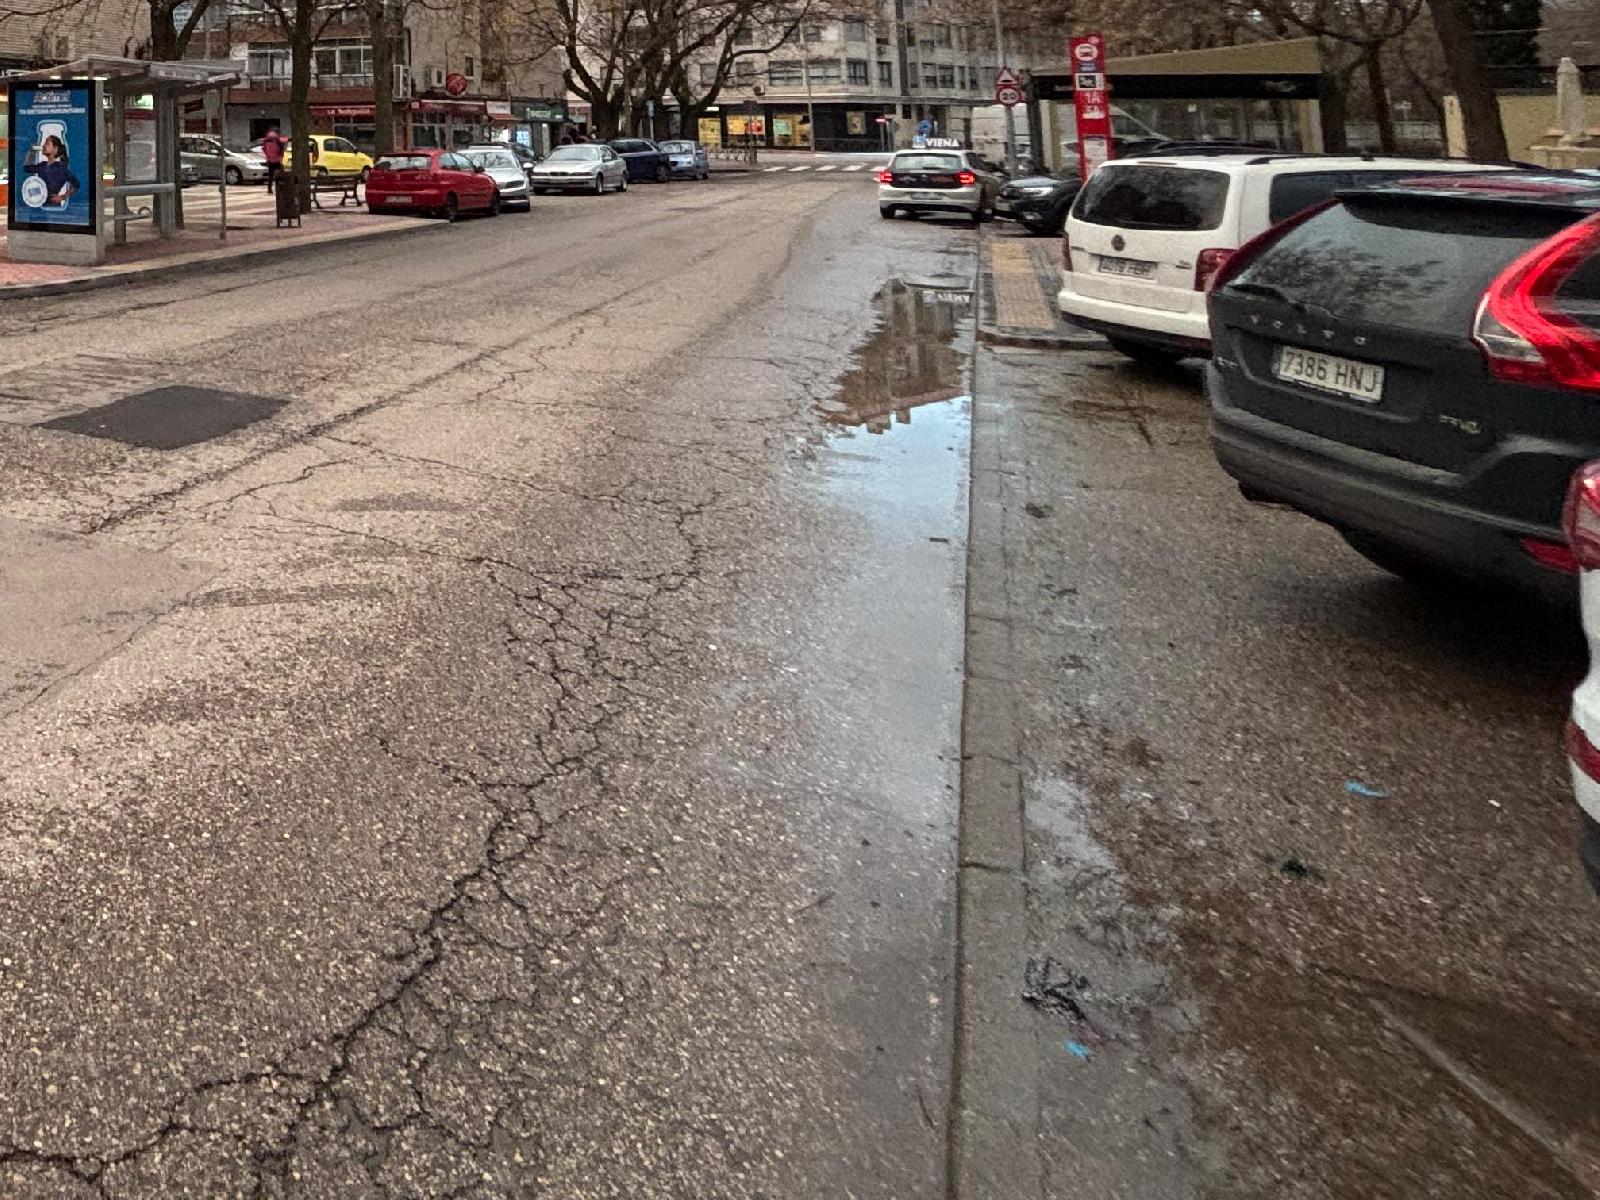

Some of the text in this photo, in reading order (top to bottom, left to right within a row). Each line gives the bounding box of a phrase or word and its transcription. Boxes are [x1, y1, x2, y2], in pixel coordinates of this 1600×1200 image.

[1002, 92, 1016, 101] 20
[926, 138, 960, 147] VIENA
[1284, 351, 1377, 393] 7386 HNJ
